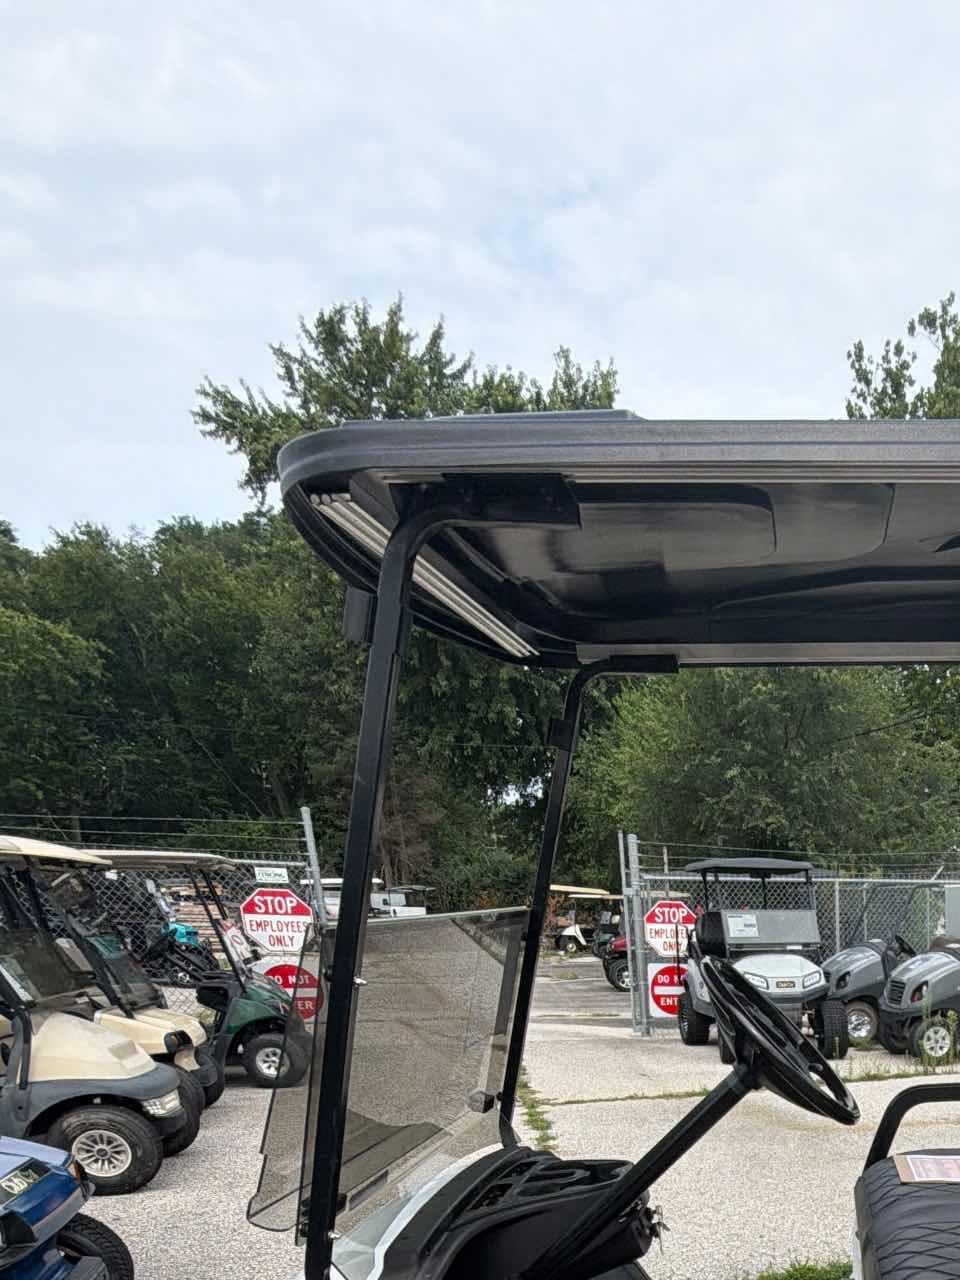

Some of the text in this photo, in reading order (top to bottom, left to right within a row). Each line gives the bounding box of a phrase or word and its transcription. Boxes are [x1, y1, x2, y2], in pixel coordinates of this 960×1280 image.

[254, 896, 298, 914] STOP
[654, 907, 688, 923] STOP
[250, 919, 308, 933] EMPLOYEES
[649, 928, 688, 939] EMPLOE
[268, 935, 296, 948] ONLY
[657, 974, 670, 984] DO
[660, 997, 679, 1006] ENT
